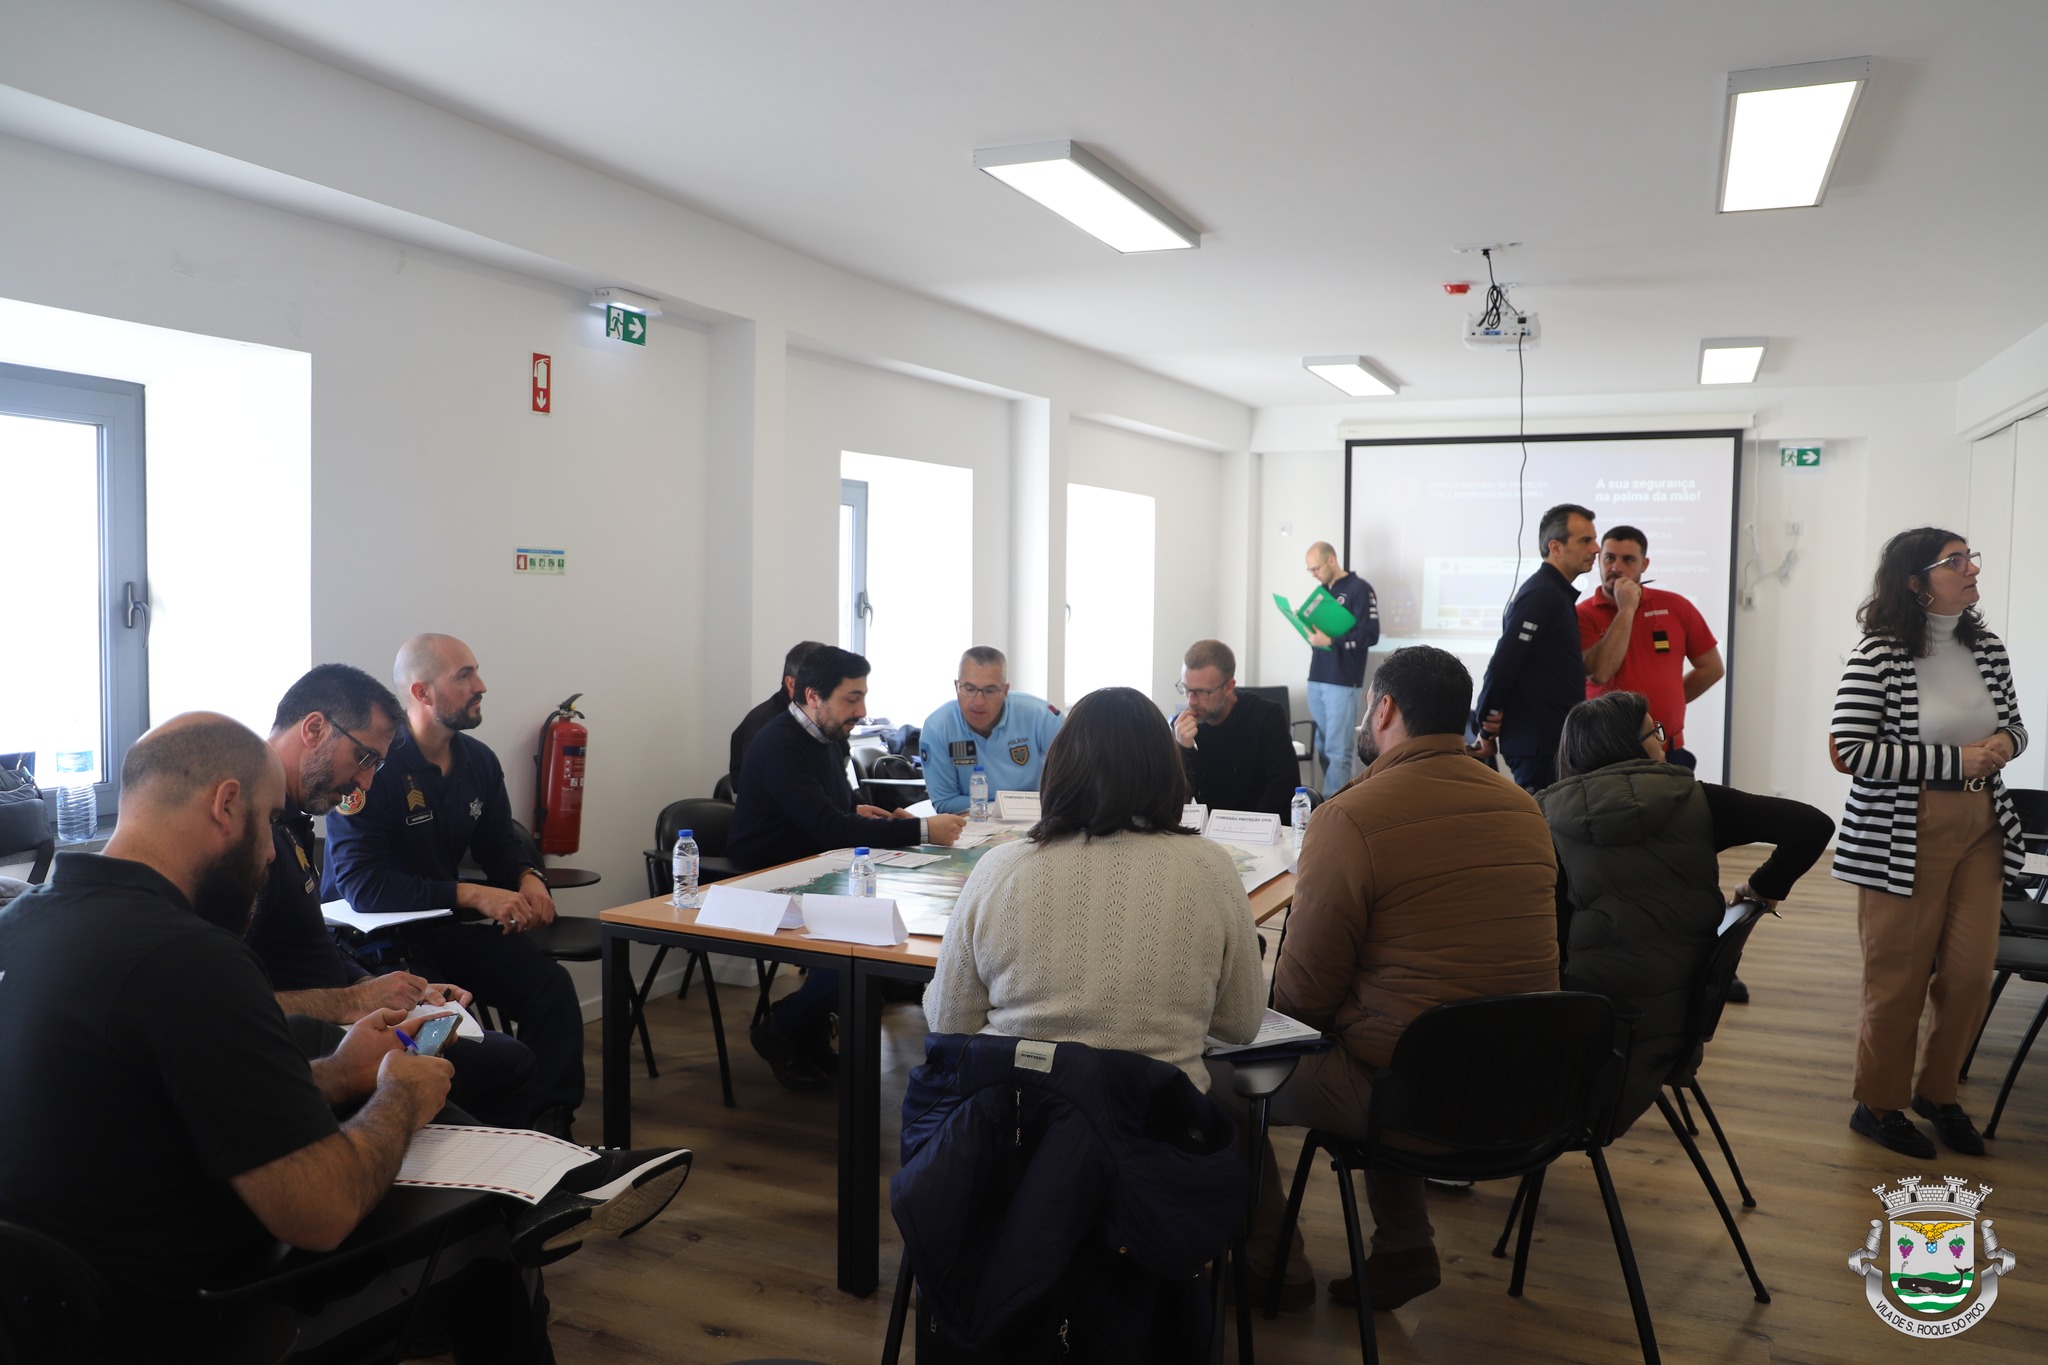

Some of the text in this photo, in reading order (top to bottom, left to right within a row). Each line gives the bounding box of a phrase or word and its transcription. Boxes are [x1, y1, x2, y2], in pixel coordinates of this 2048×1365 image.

[1596, 478, 1696, 492] A sua segurança
[1595, 490, 1701, 504] na palma da mão!
